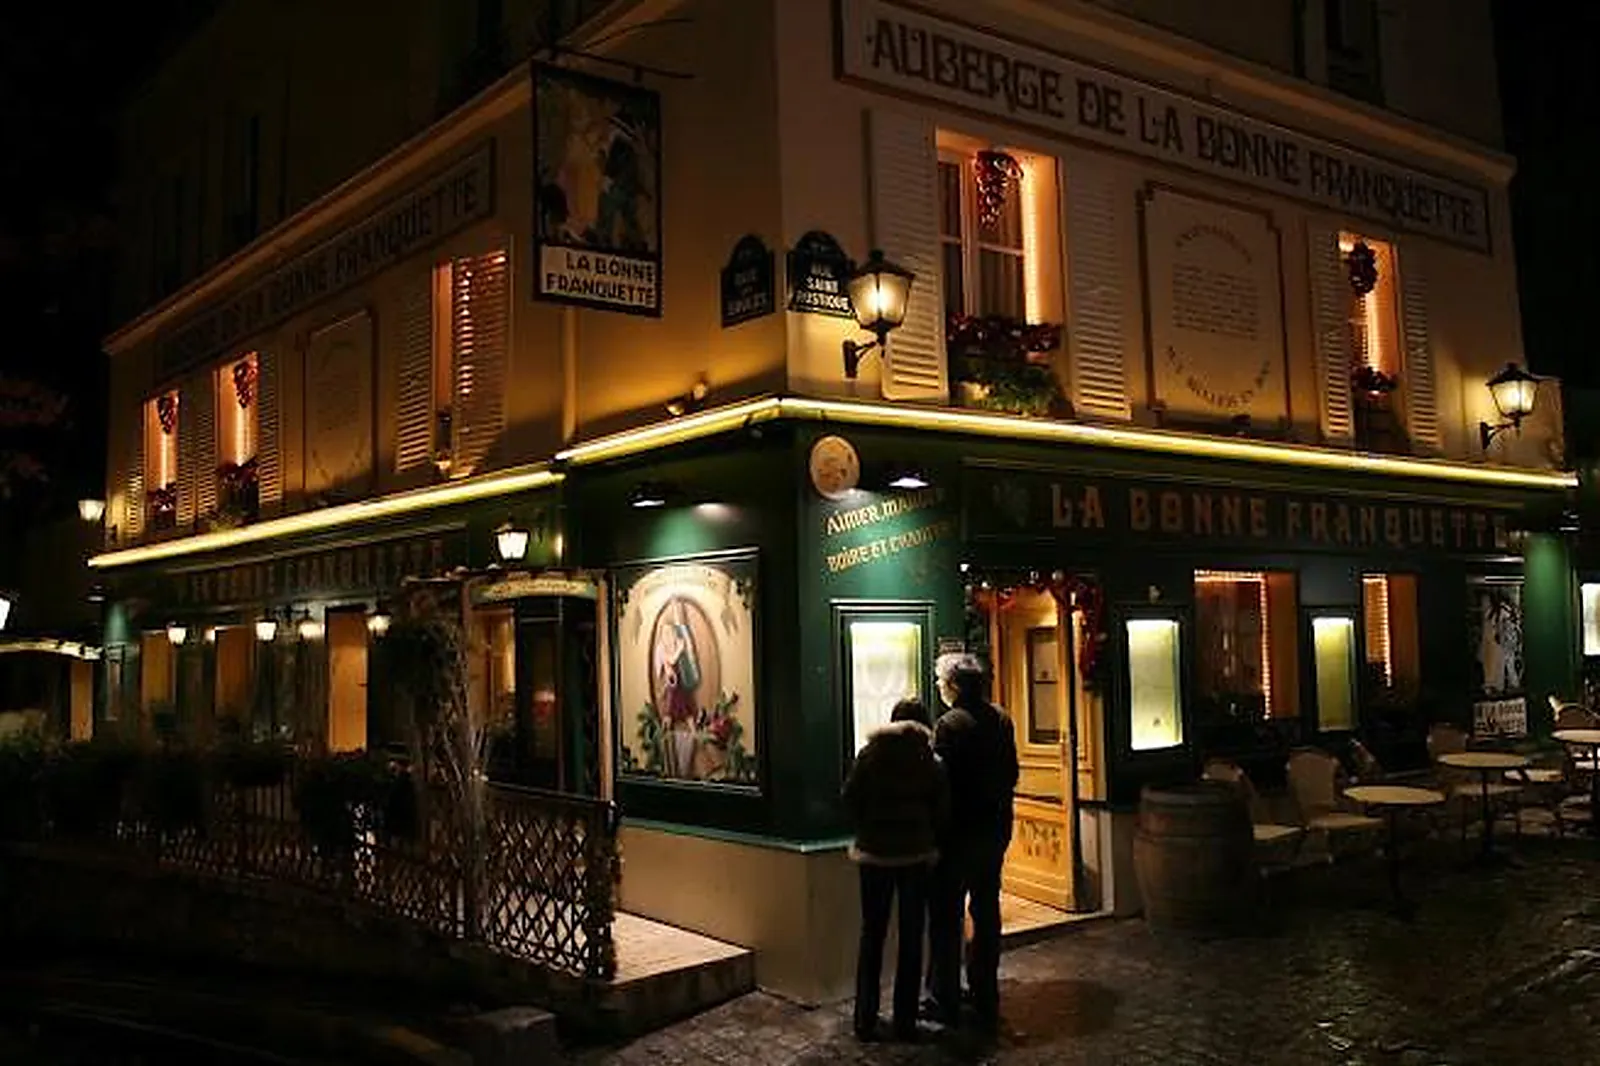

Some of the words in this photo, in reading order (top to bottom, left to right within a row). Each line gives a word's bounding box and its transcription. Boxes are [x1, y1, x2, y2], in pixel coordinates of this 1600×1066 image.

[872, 19, 1065, 119] AUBERGE
[1076, 77, 1127, 137] DE
[1136, 96, 1184, 154] LA
[1197, 116, 1301, 186] BONNE
[1309, 151, 1477, 236] FRANQUETTE
[546, 273, 655, 305] FRANQUETTE
[566, 251, 590, 271] LA
[595, 257, 655, 283] BONNE
[1050, 483, 1104, 529] LA
[1130, 488, 1267, 537] BONNE
[1287, 501, 1507, 549] FRANQUETTE
